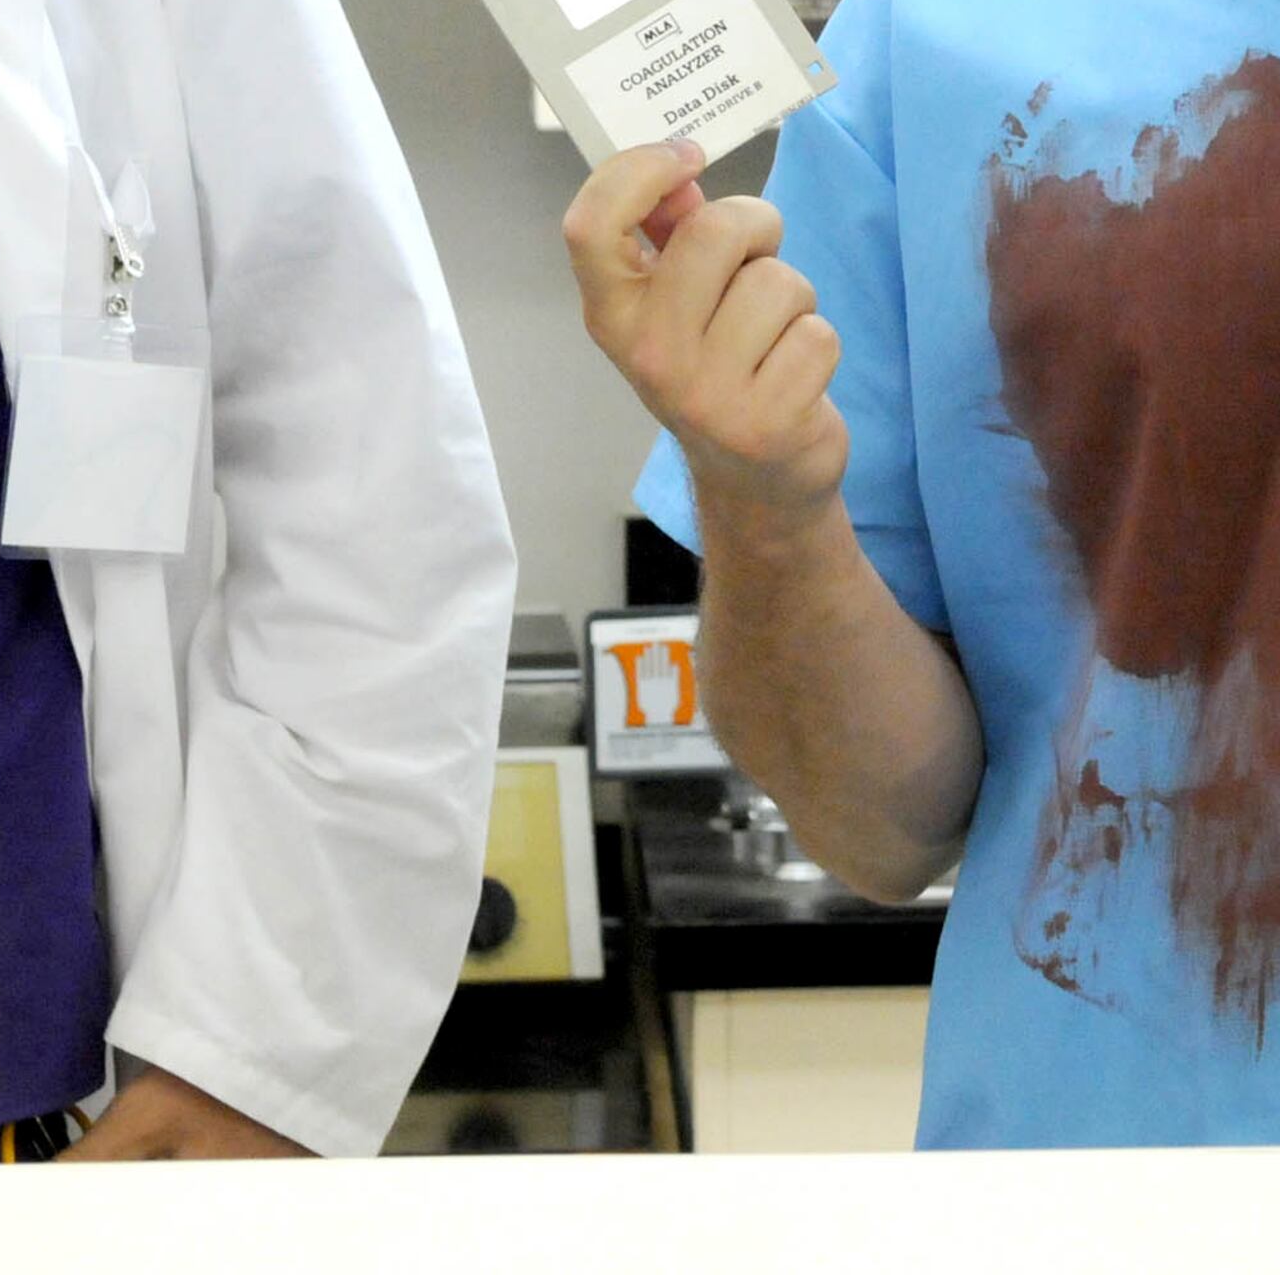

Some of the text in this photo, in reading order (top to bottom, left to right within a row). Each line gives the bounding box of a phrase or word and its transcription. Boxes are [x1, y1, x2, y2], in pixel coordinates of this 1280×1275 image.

[619, 19, 729, 92] COAGULATION
[642, 19, 674, 44] MLA
[644, 43, 726, 100] ANALYZER
[662, 74, 740, 126] Data Disk
[664, 117, 702, 144] NSERT
[701, 108, 718, 123] IN
[716, 86, 753, 114] DRIVE
